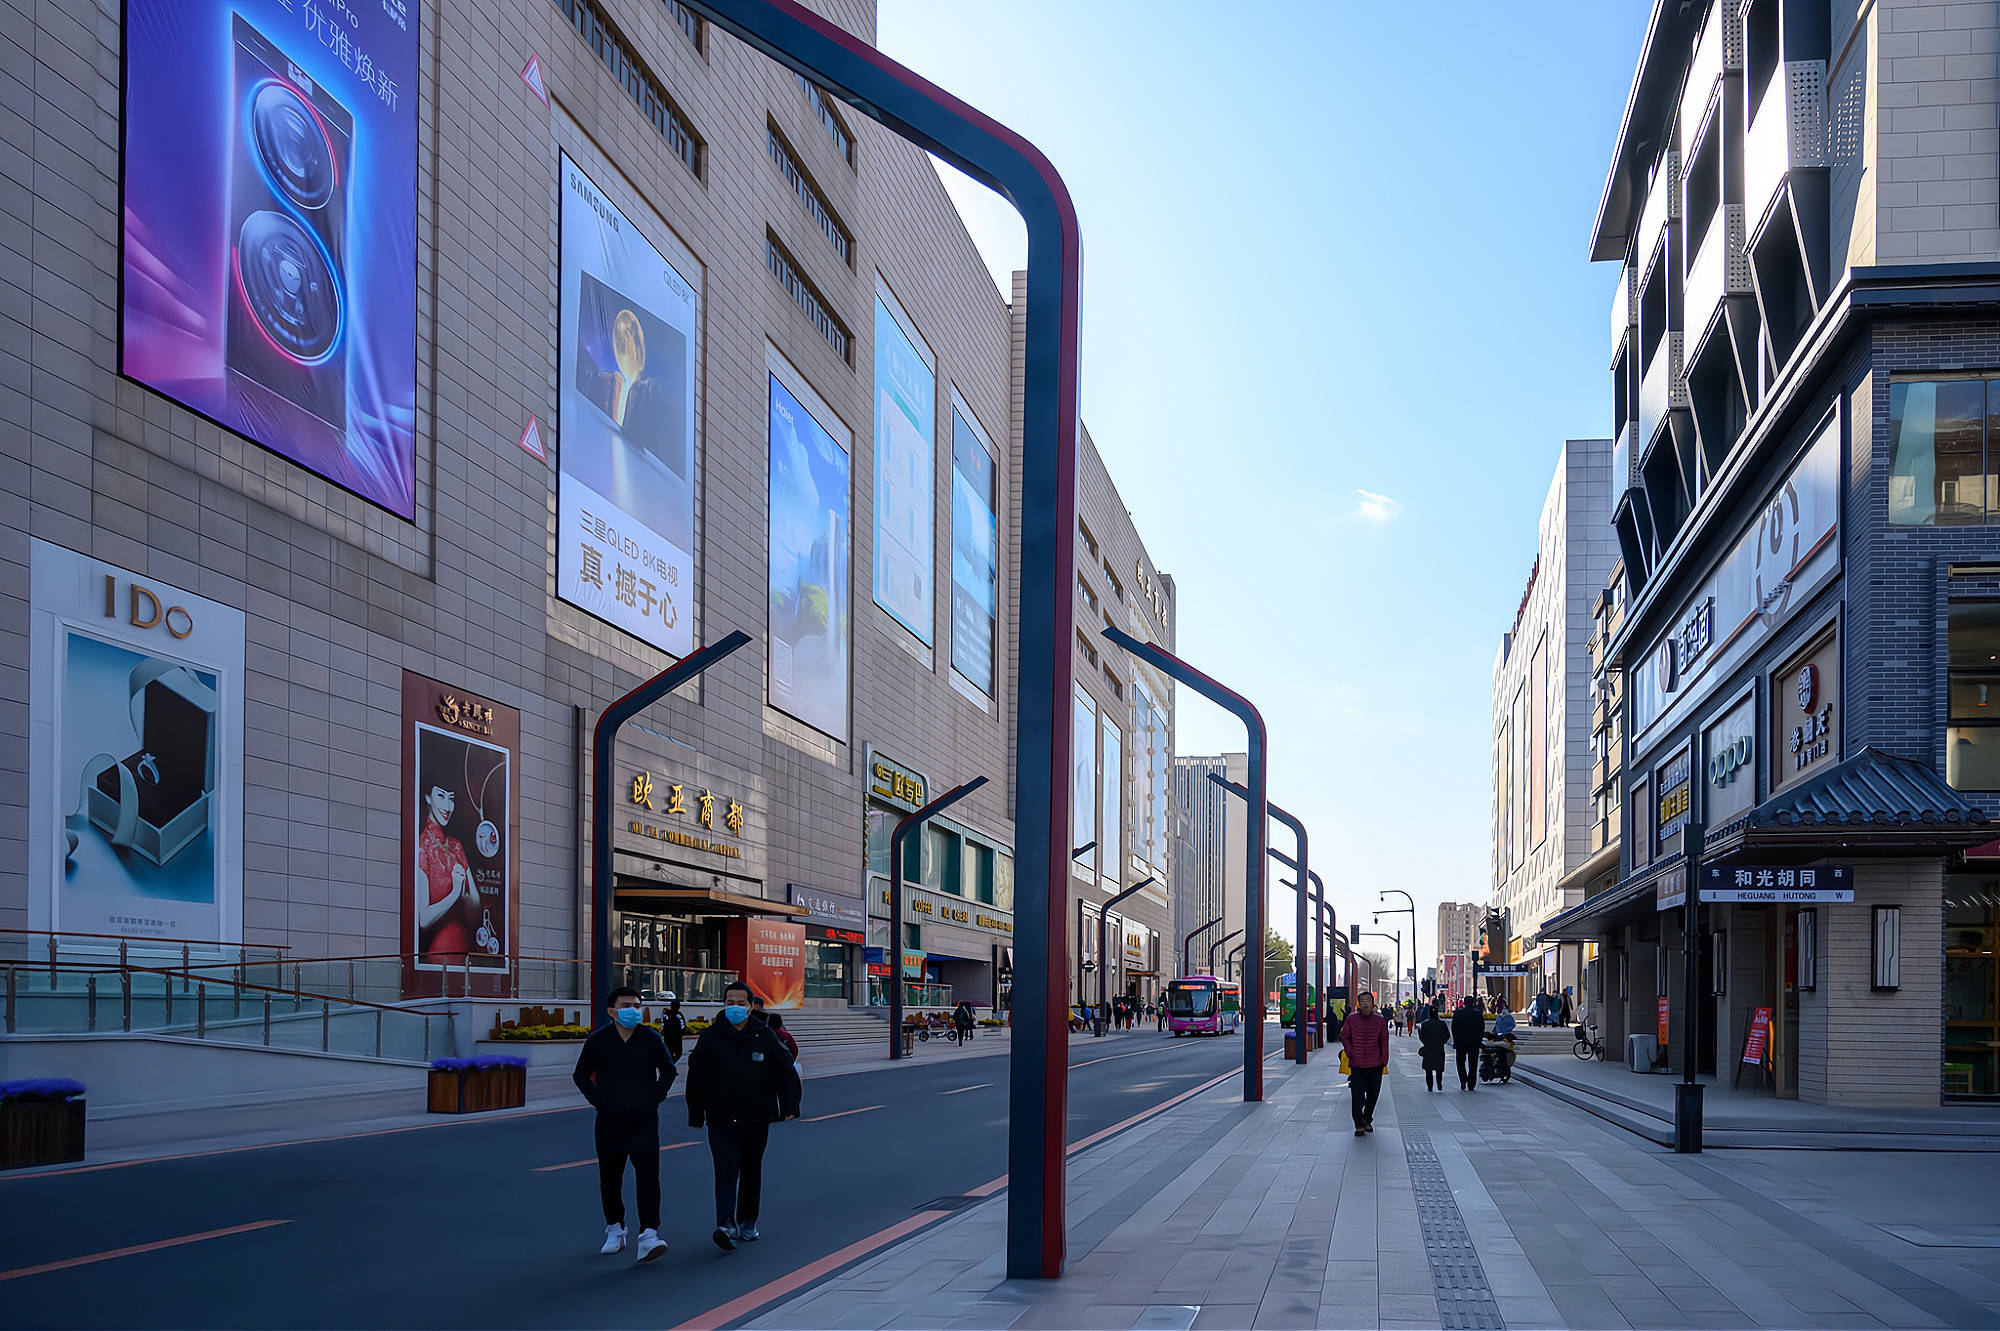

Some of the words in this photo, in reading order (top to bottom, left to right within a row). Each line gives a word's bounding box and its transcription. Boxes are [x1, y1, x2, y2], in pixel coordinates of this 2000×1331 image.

[570, 172, 619, 233] SAMSUNG
[580, 508, 640, 561] 三星QLED
[642, 549, 679, 588] 8K电视
[580, 541, 678, 630] 真·撼于心
[633, 770, 744, 839] 欧亚商都
[1711, 869, 1720, 878] 东
[1735, 869, 1816, 888] 和光胡同
[1834, 869, 1843, 878] 西
[1712, 891, 1718, 899] E
[1737, 892, 1776, 900] HEGUANG
[1783, 892, 1816, 900] HUTONG
